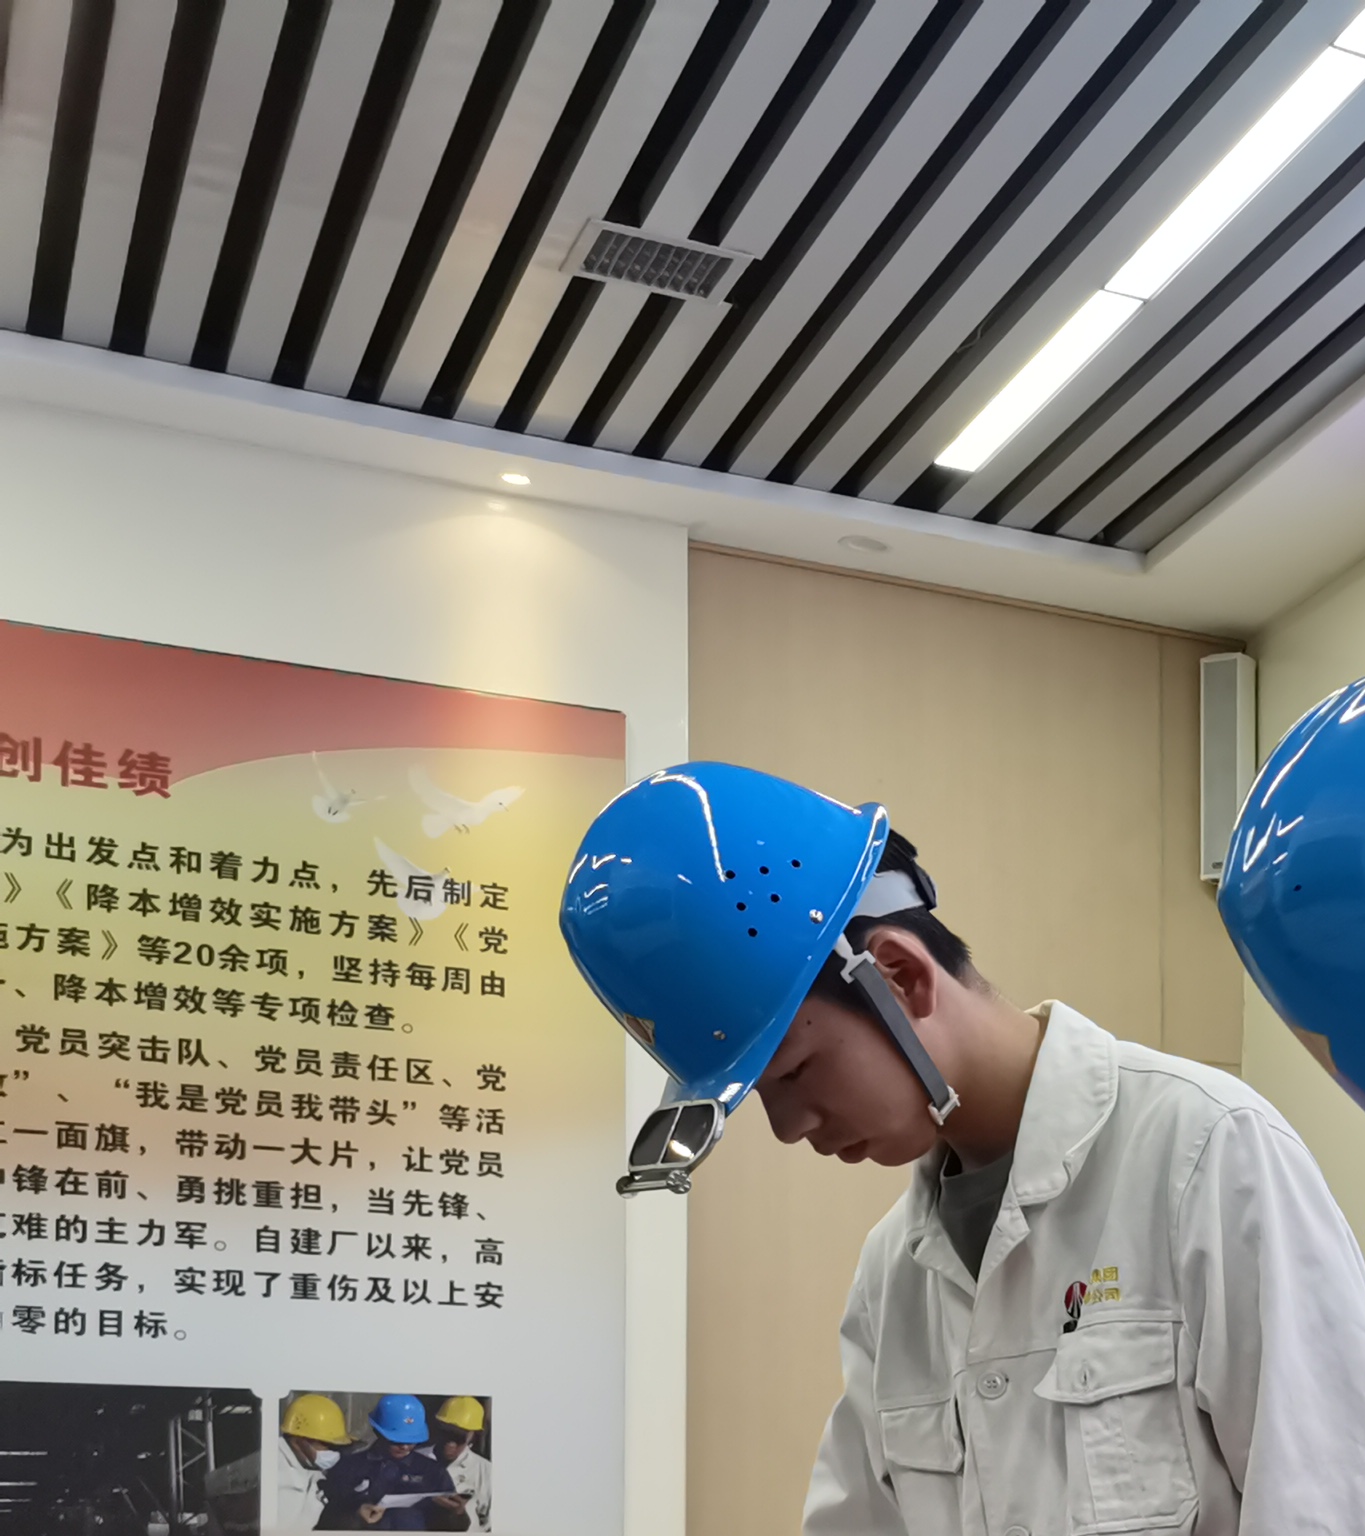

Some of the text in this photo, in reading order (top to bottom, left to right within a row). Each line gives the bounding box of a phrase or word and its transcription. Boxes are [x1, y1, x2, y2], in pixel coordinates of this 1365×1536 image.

[0, 732, 173, 799] 创佳绩
[0, 974, 417, 1036] 、降本增效等专项检查。
[0, 1068, 506, 1136] ”、“我是党员我带头”等活
[0, 1120, 505, 1178] 一面旗，带动一大片，让党员
[0, 1166, 496, 1223] 锋在前、勇挑重担，当先锋、
[0, 1213, 504, 1267] 难的主力军。自建厂以来，高
[0, 1259, 505, 1311] 标任务，实现了重伤及以上安
[0, 1304, 190, 1342] 零的目标。
